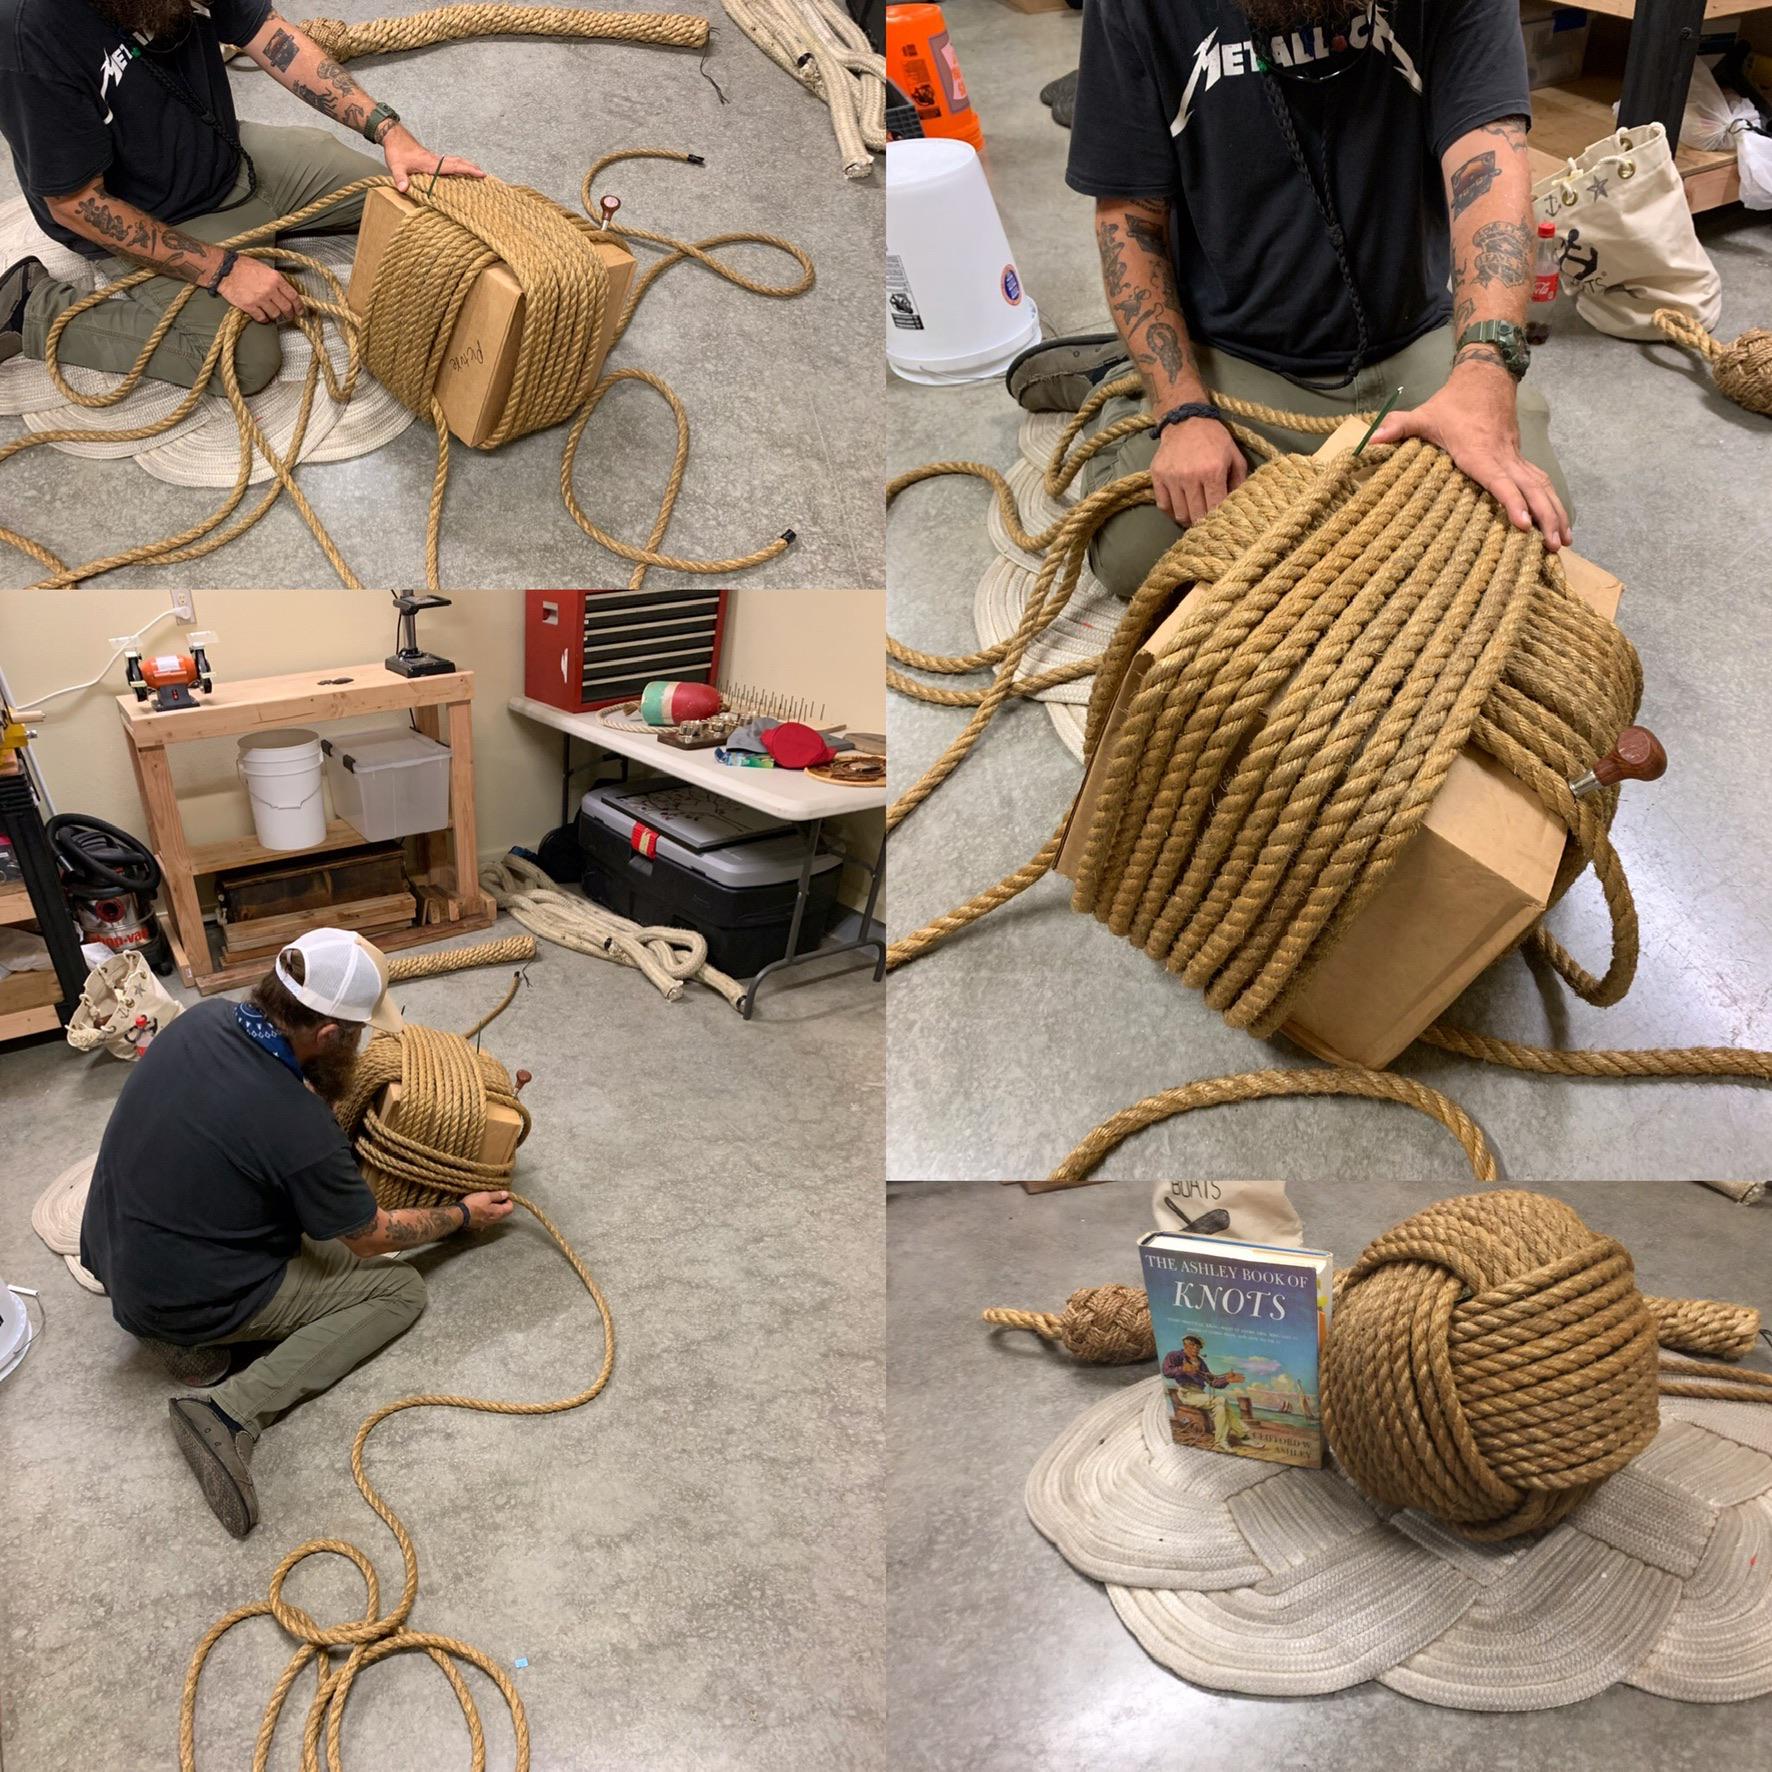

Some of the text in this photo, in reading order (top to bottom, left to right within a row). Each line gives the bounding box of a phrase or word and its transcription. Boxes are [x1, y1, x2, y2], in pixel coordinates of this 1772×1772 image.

[1170, 1, 1423, 138] METALLCA
[1145, 1254, 1309, 1289] THE ASHLEY BOOK OF
[1173, 1280, 1286, 1321] KNOTS
